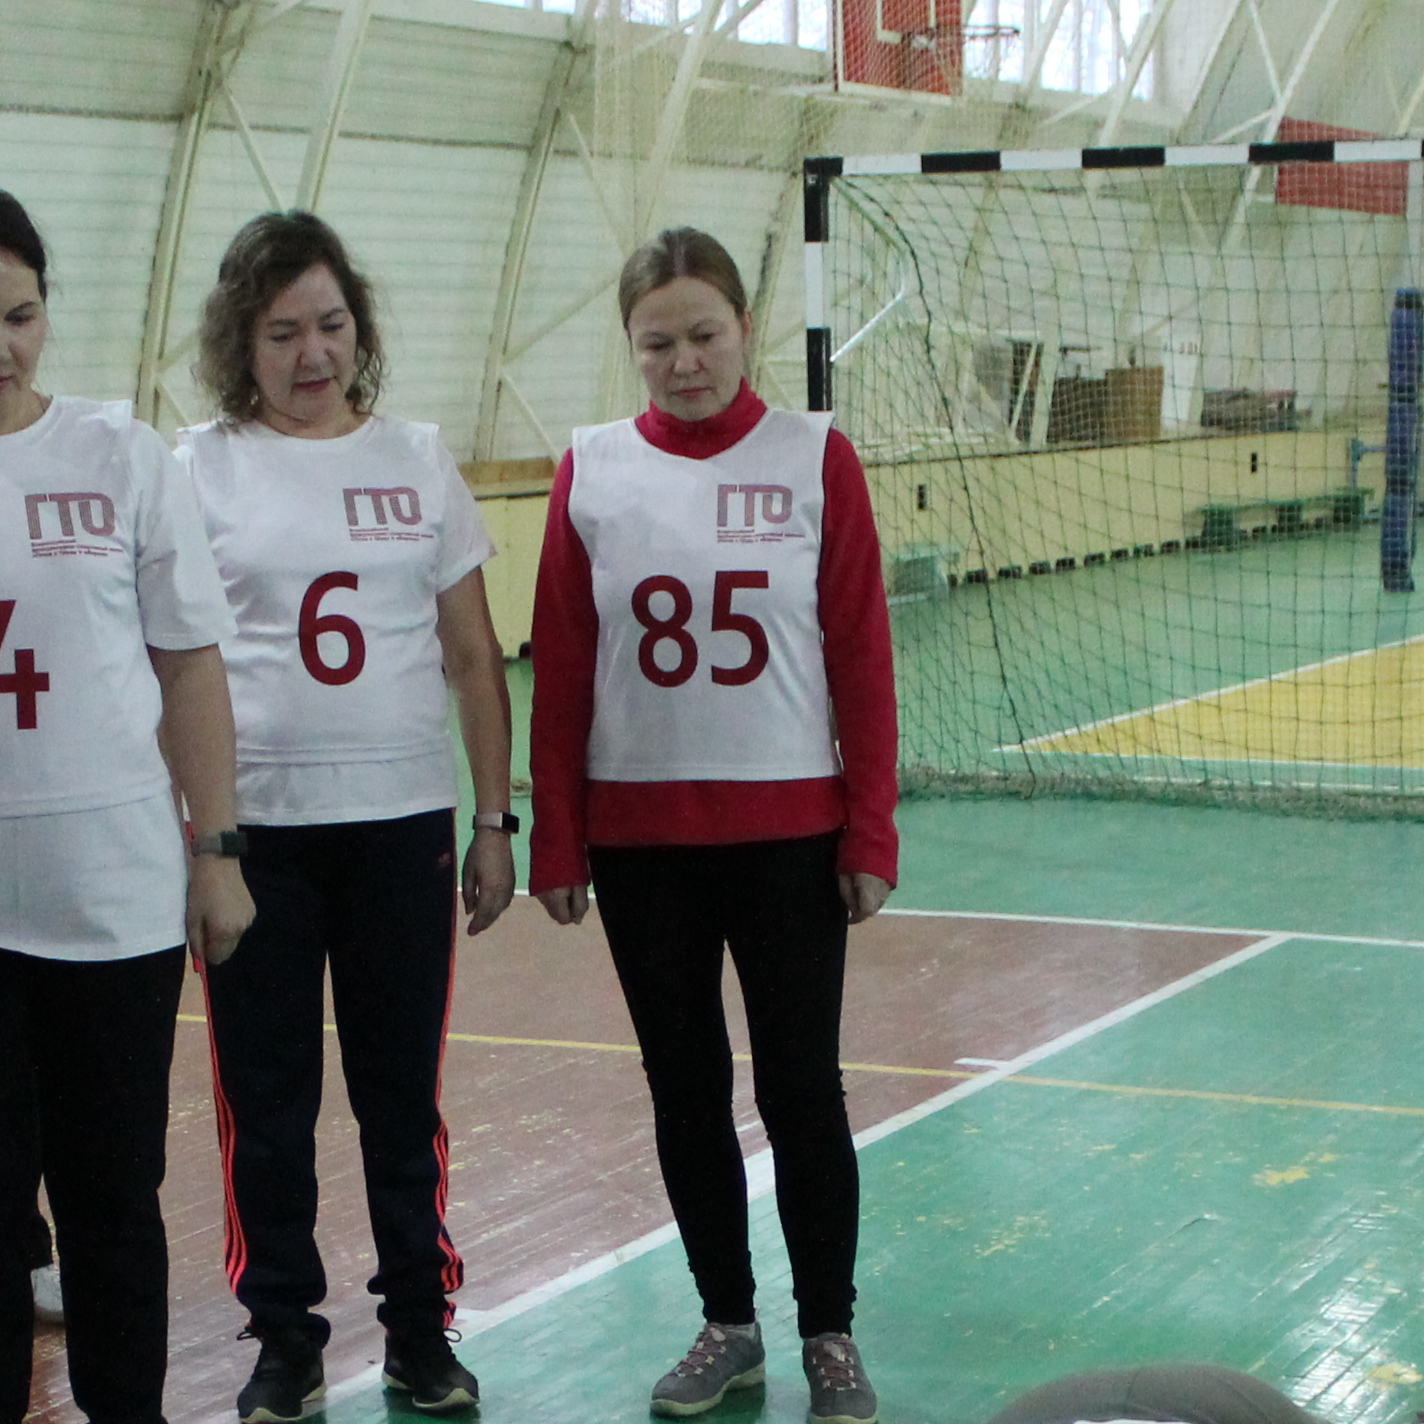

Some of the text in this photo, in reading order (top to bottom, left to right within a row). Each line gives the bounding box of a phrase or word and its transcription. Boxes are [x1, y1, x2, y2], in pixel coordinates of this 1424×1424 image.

[24, 492, 116, 540] ГТО
[343, 486, 422, 526] ГТО
[717, 484, 793, 527] ГТО
[298, 571, 366, 686] 6
[631, 570, 770, 688] 85
